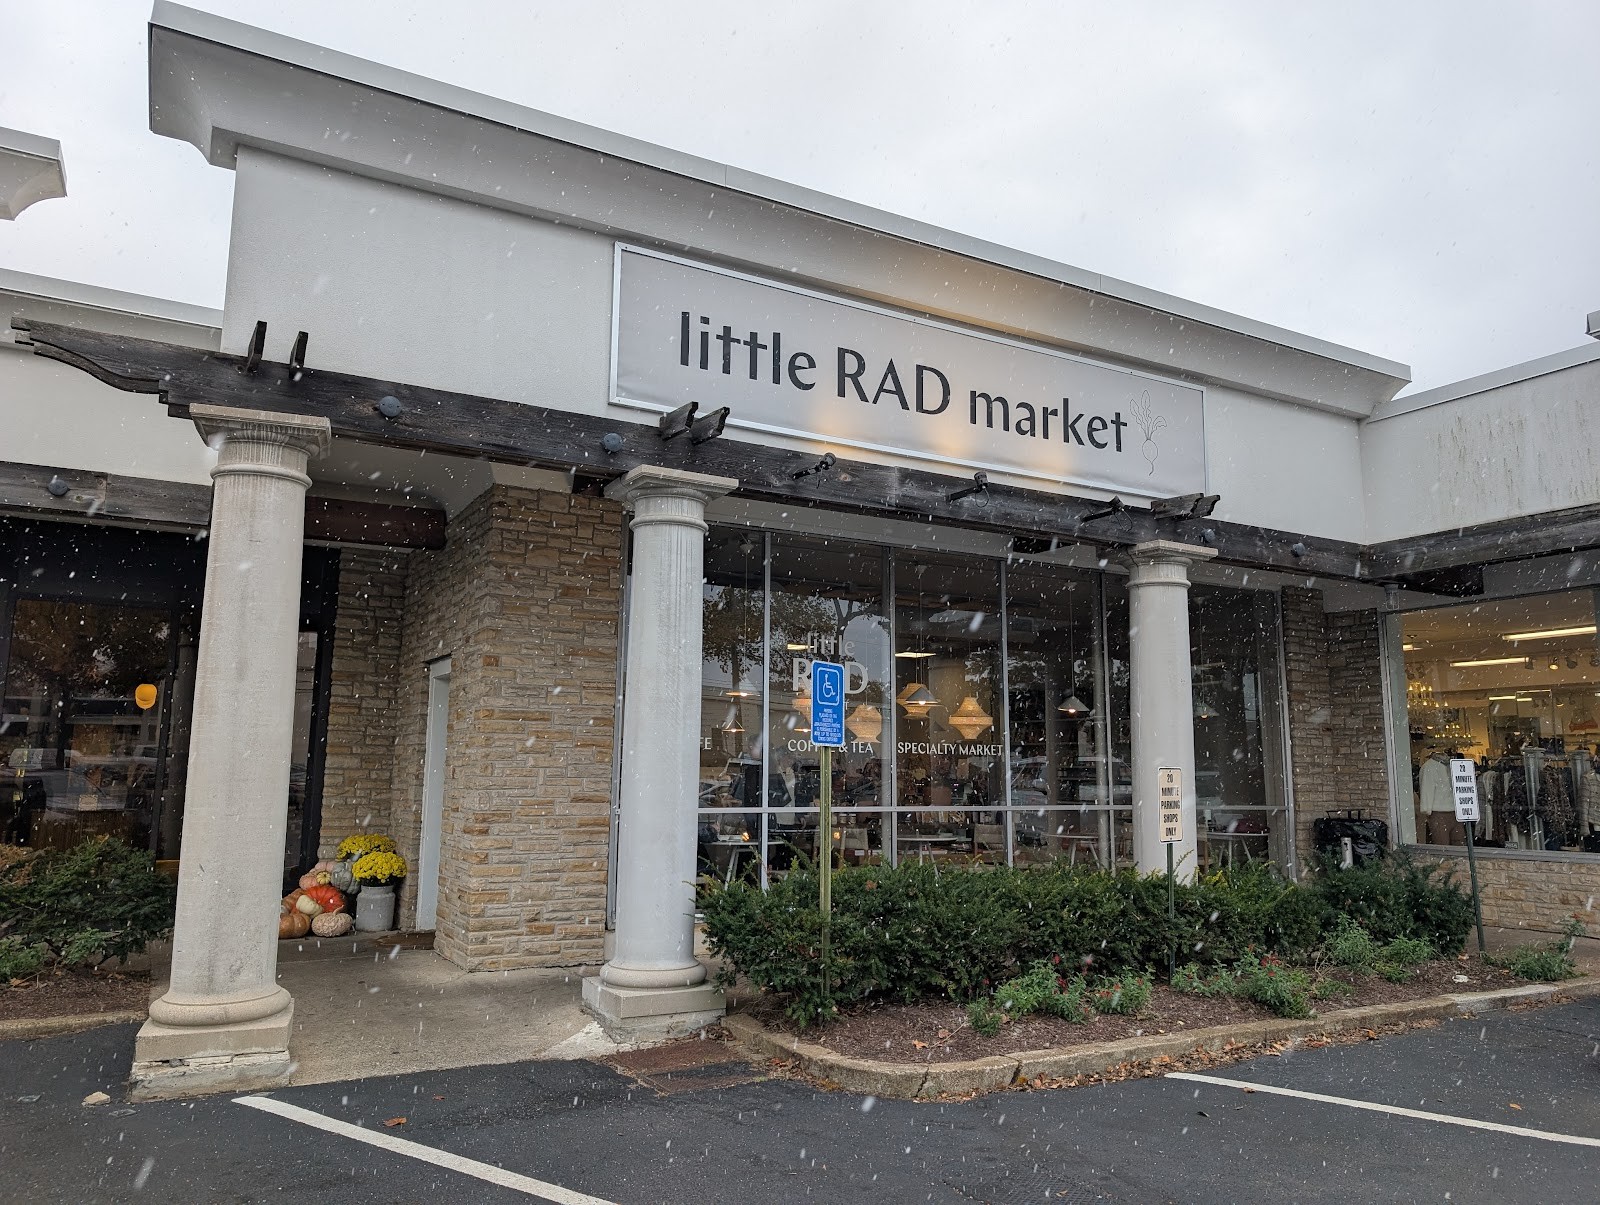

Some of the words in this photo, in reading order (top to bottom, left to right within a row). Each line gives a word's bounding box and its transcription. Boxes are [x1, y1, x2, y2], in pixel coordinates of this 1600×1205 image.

[680, 311, 816, 391] little
[837, 347, 951, 415] RAD
[969, 390, 1128, 453] market
[807, 632, 855, 656] little
[792, 657, 868, 694] RD
[851, 741, 874, 754] TEA
[897, 741, 957, 755] SPECIALTY
[959, 743, 1003, 756] MARKET
[1166, 773, 1174, 783] 20
[1161, 786, 1179, 796] MINUTE
[1455, 786, 1475, 794] PARKING
[1160, 800, 1180, 810] PARKING
[1163, 813, 1178, 823] SHOPS
[1165, 827, 1177, 836] ONLY
